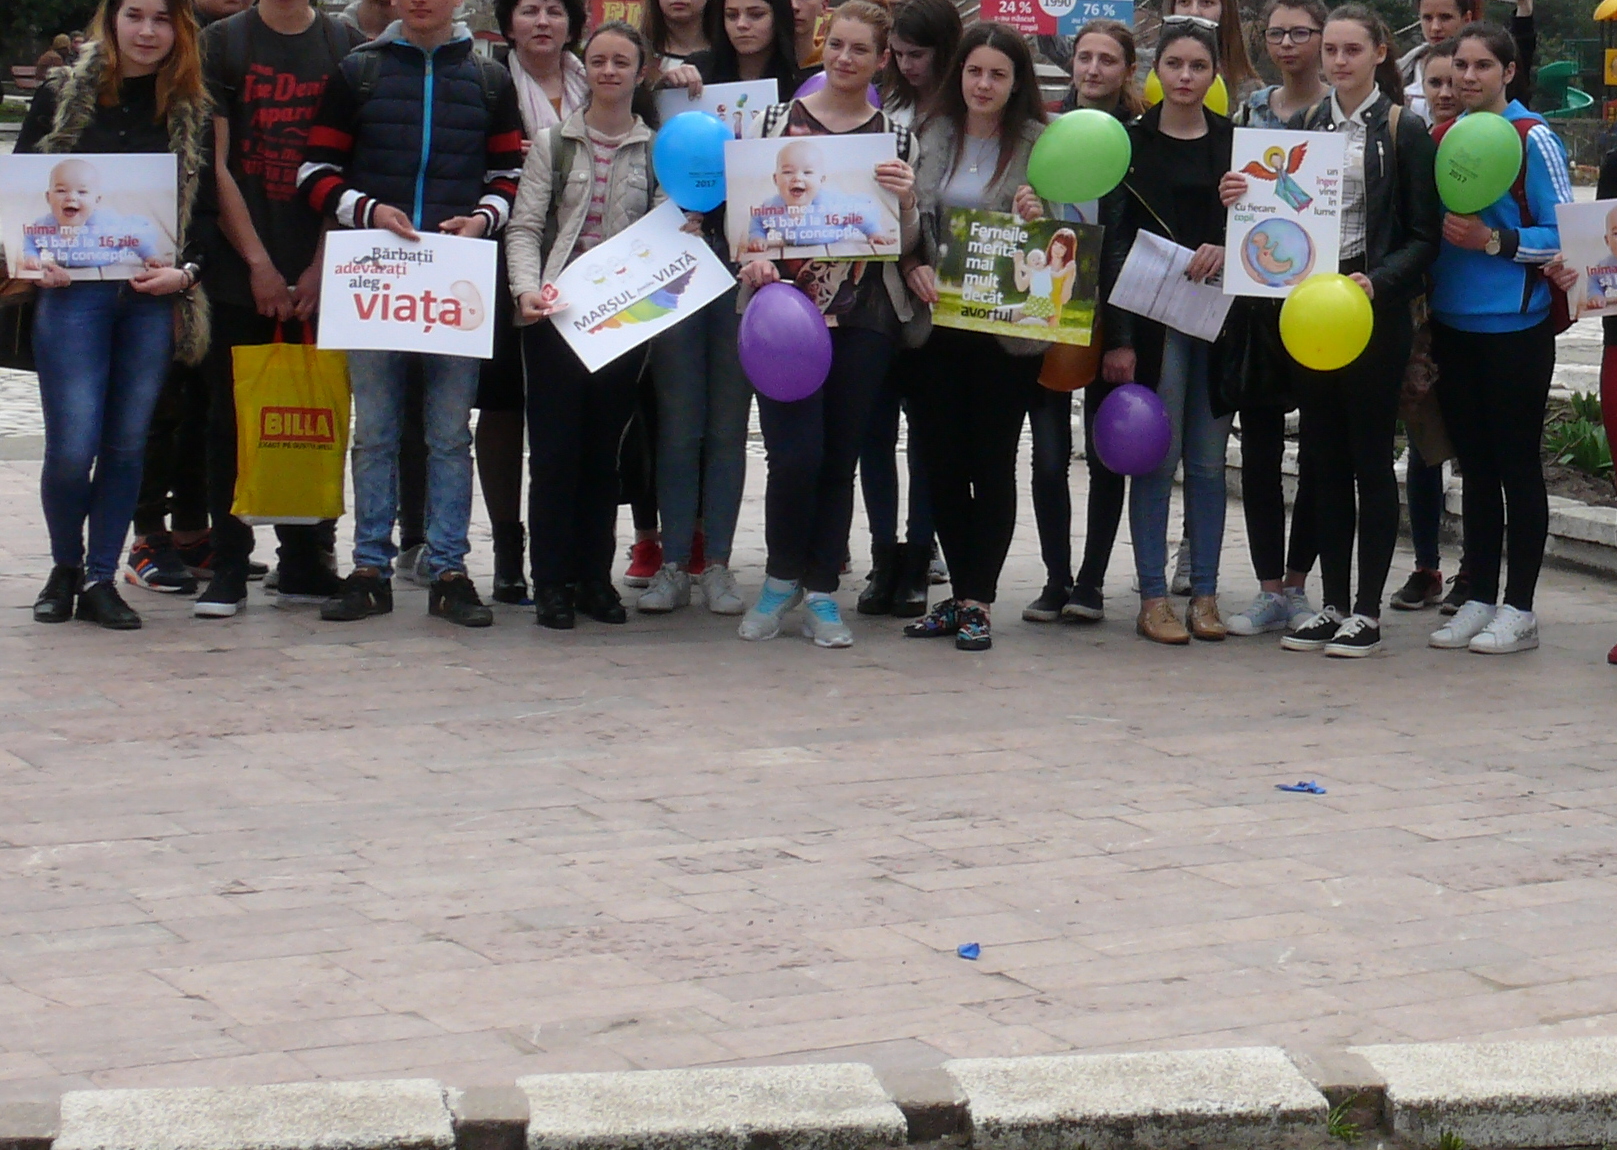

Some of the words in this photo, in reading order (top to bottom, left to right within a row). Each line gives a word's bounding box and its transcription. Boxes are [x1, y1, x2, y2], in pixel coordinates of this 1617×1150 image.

[998, 0, 1016, 14] 24
[1083, 3, 1099, 15] 76
[750, 205, 784, 217] Inima
[824, 214, 839, 226] 16
[843, 213, 863, 225] zile
[23, 224, 56, 235] Inima
[970, 221, 1029, 243] Femeile
[98, 235, 114, 248] 16
[118, 235, 140, 248] zile
[371, 247, 434, 266] Bărbații
[966, 256, 995, 271] mai
[349, 275, 380, 292] aleg
[964, 272, 1000, 288] mult
[573, 289, 636, 331] MARȘUL
[653, 250, 697, 283] VIAȚĂ
[353, 283, 462, 333] viața
[960, 305, 1013, 322] avortul
[264, 412, 331, 438] BILLA
